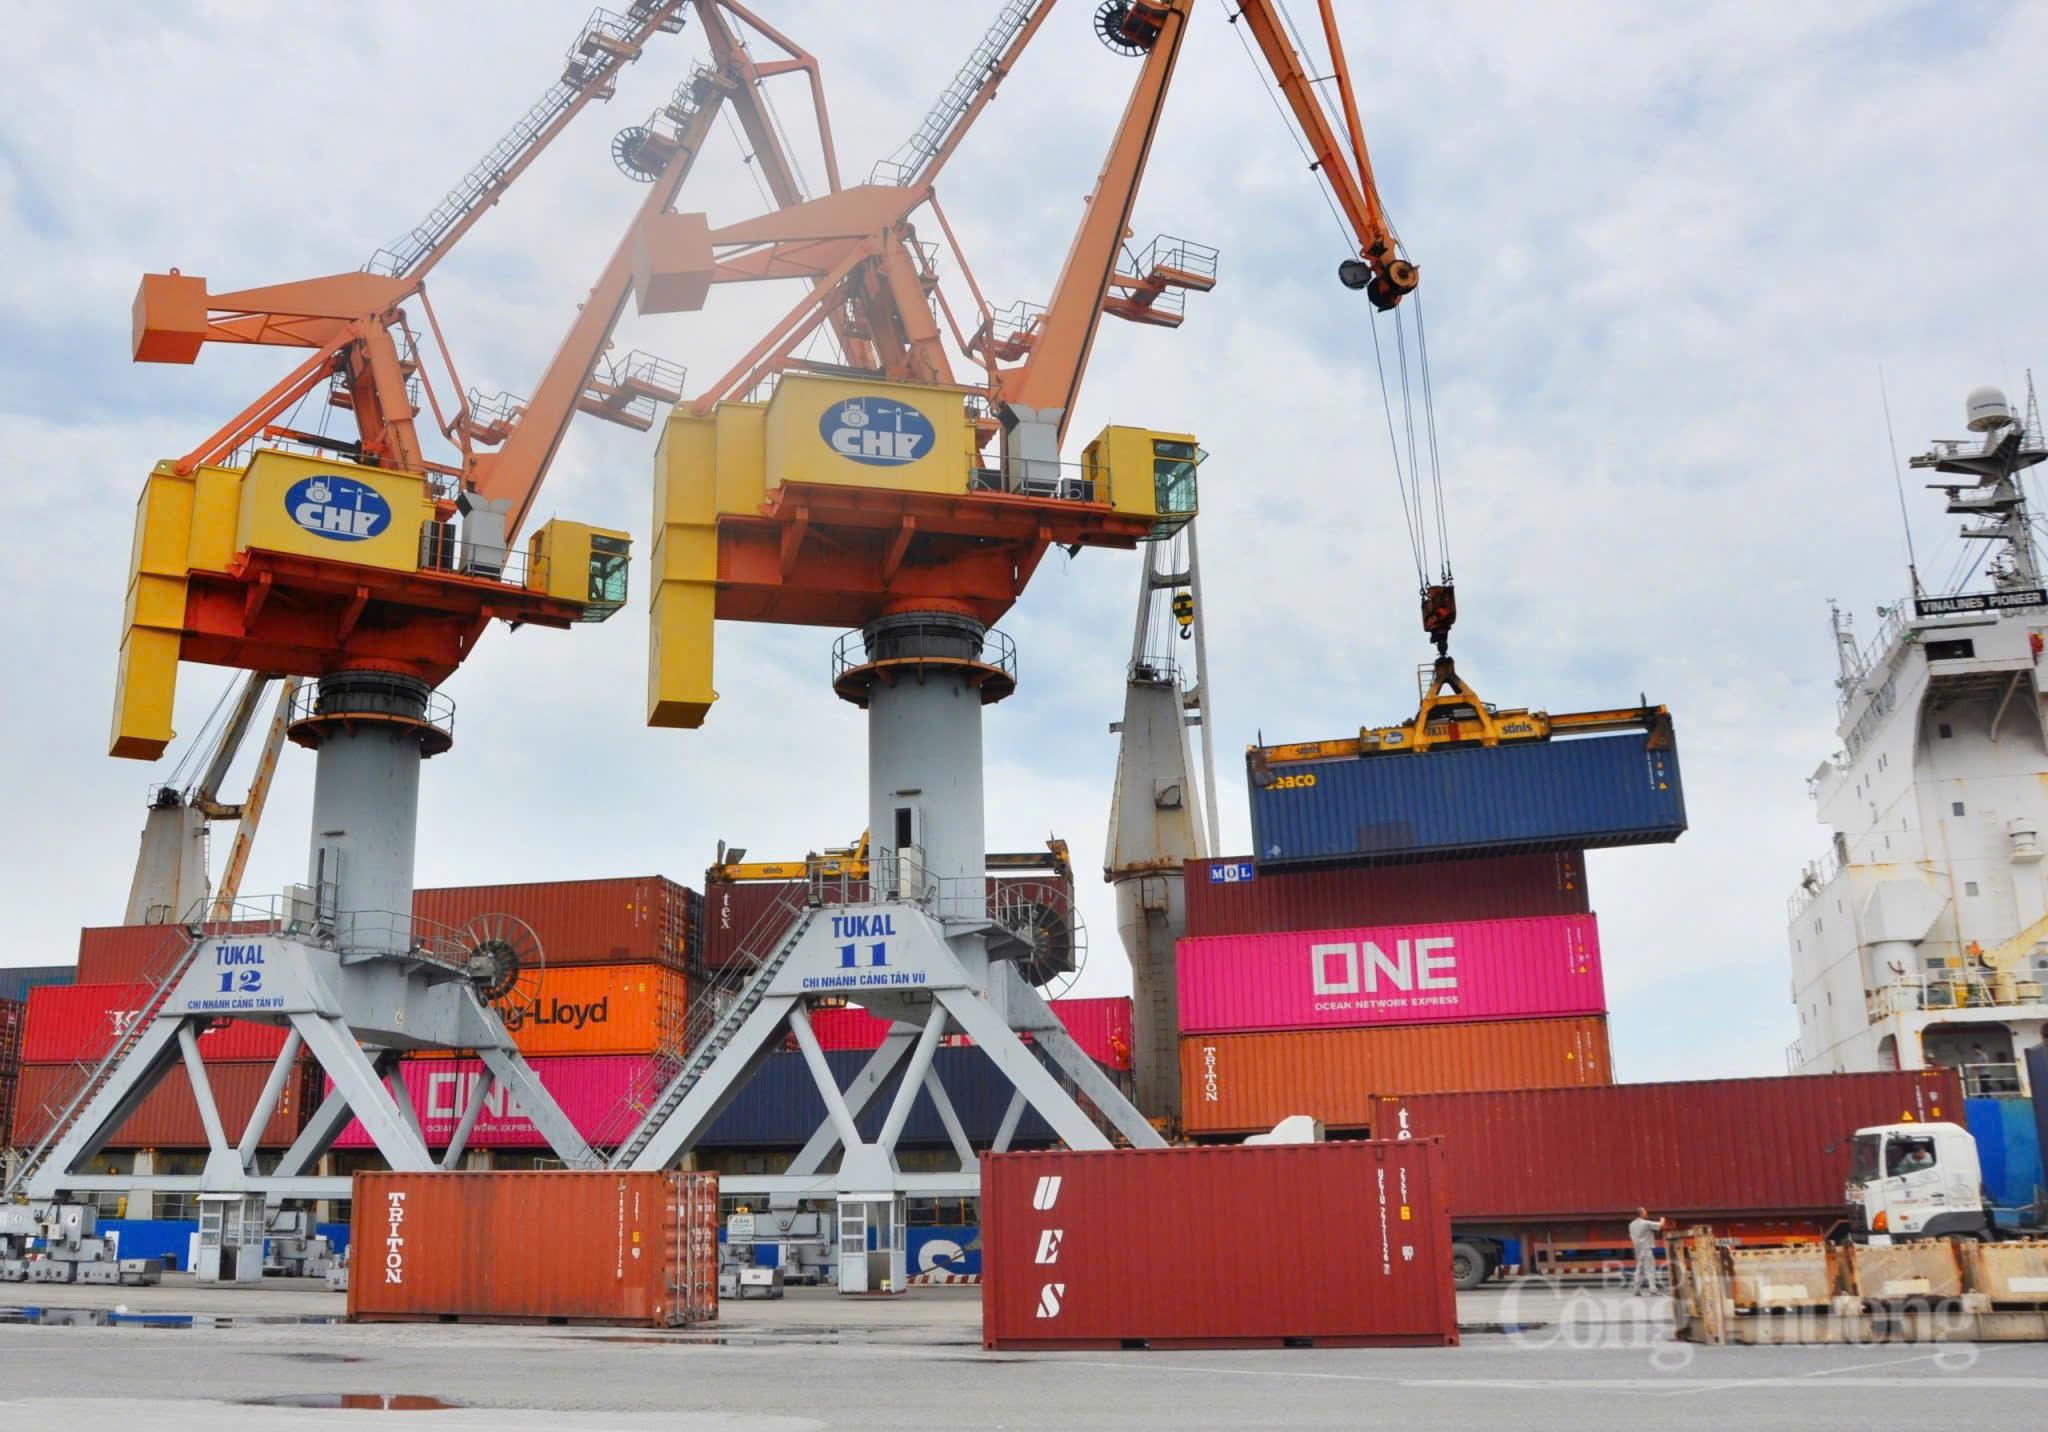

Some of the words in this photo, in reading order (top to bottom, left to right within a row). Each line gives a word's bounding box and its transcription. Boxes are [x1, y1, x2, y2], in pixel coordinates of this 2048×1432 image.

[1921, 597, 1985, 613] VINALINES
[1988, 592, 2042, 607] PIONEER
[1211, 866, 1251, 880] MOL
[831, 914, 896, 938] TUKAL
[215, 944, 265, 966] TUKAL
[834, 941, 893, 969] 11
[1311, 937, 1457, 996] ONE
[215, 969, 263, 993] 12
[802, 977, 820, 989] CHI
[821, 973, 857, 987] NHÁNH
[187, 1000, 201, 1010] CHI
[1315, 1000, 1352, 1011] OCEAN
[1355, 998, 1408, 1010] NETWORK
[1411, 996, 1460, 1007] EXPRESS
[1203, 1046, 1219, 1102] TRITON
[385, 1191, 406, 1284] TRITON
[1032, 1176, 1066, 1318] UES
